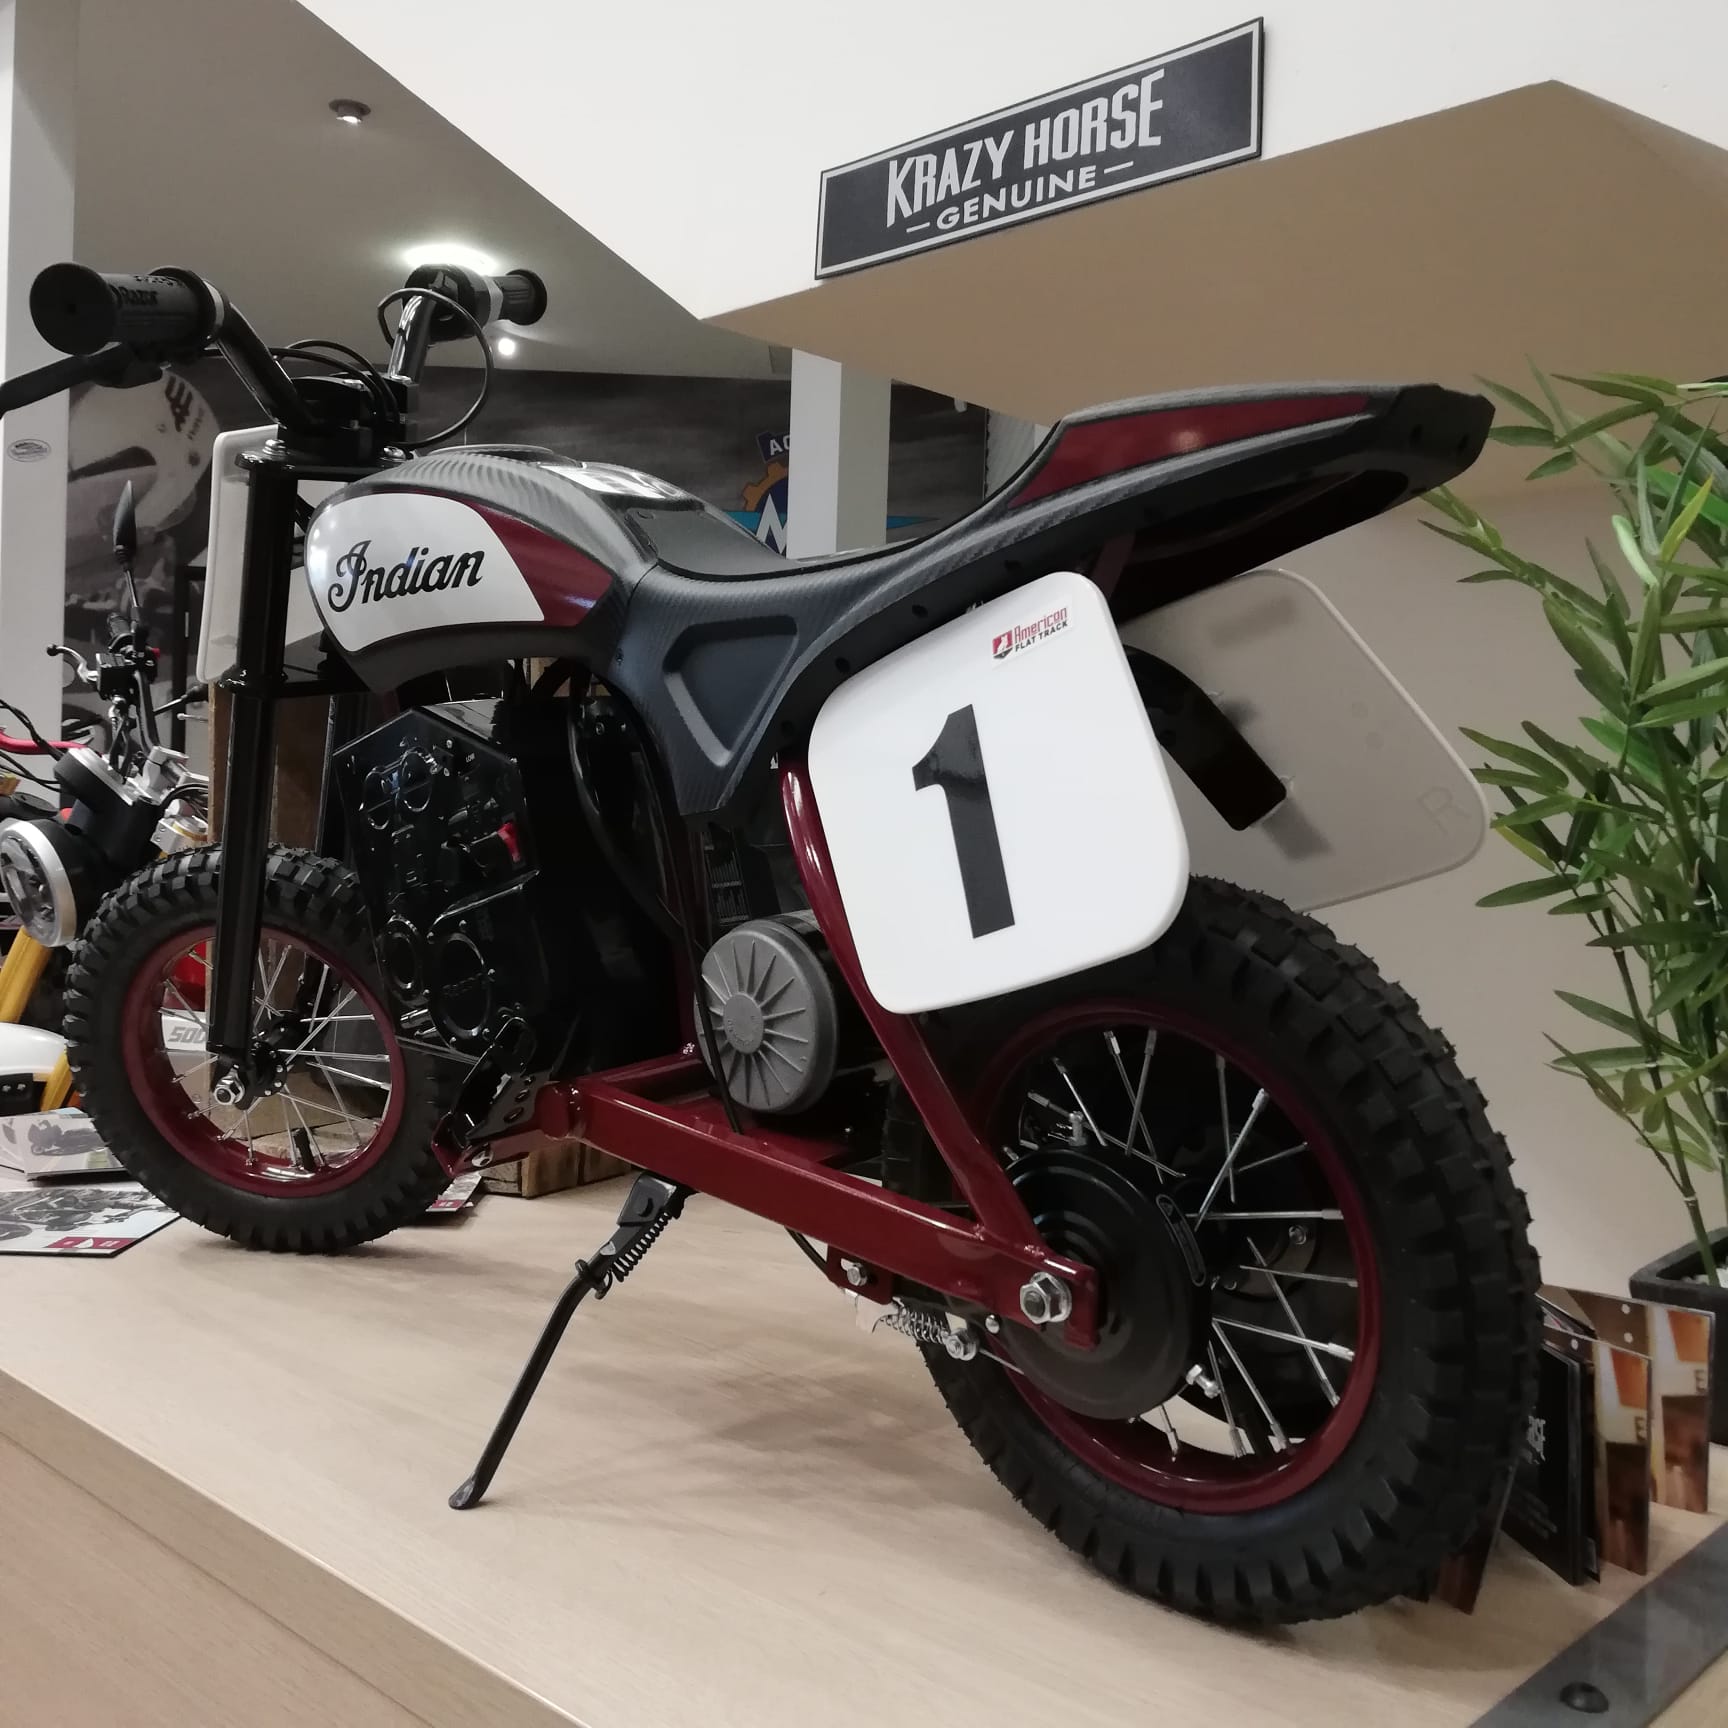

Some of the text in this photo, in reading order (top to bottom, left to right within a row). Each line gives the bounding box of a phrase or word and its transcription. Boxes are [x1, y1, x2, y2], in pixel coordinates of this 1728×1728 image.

[887, 68, 1165, 228] KRAZY HORSE
[936, 168, 1096, 230] GENUINE
[327, 539, 485, 612] Indian
[1014, 607, 1068, 643] American
[1015, 620, 1068, 652] FLAT TRACK
[911, 703, 1016, 939] 1
